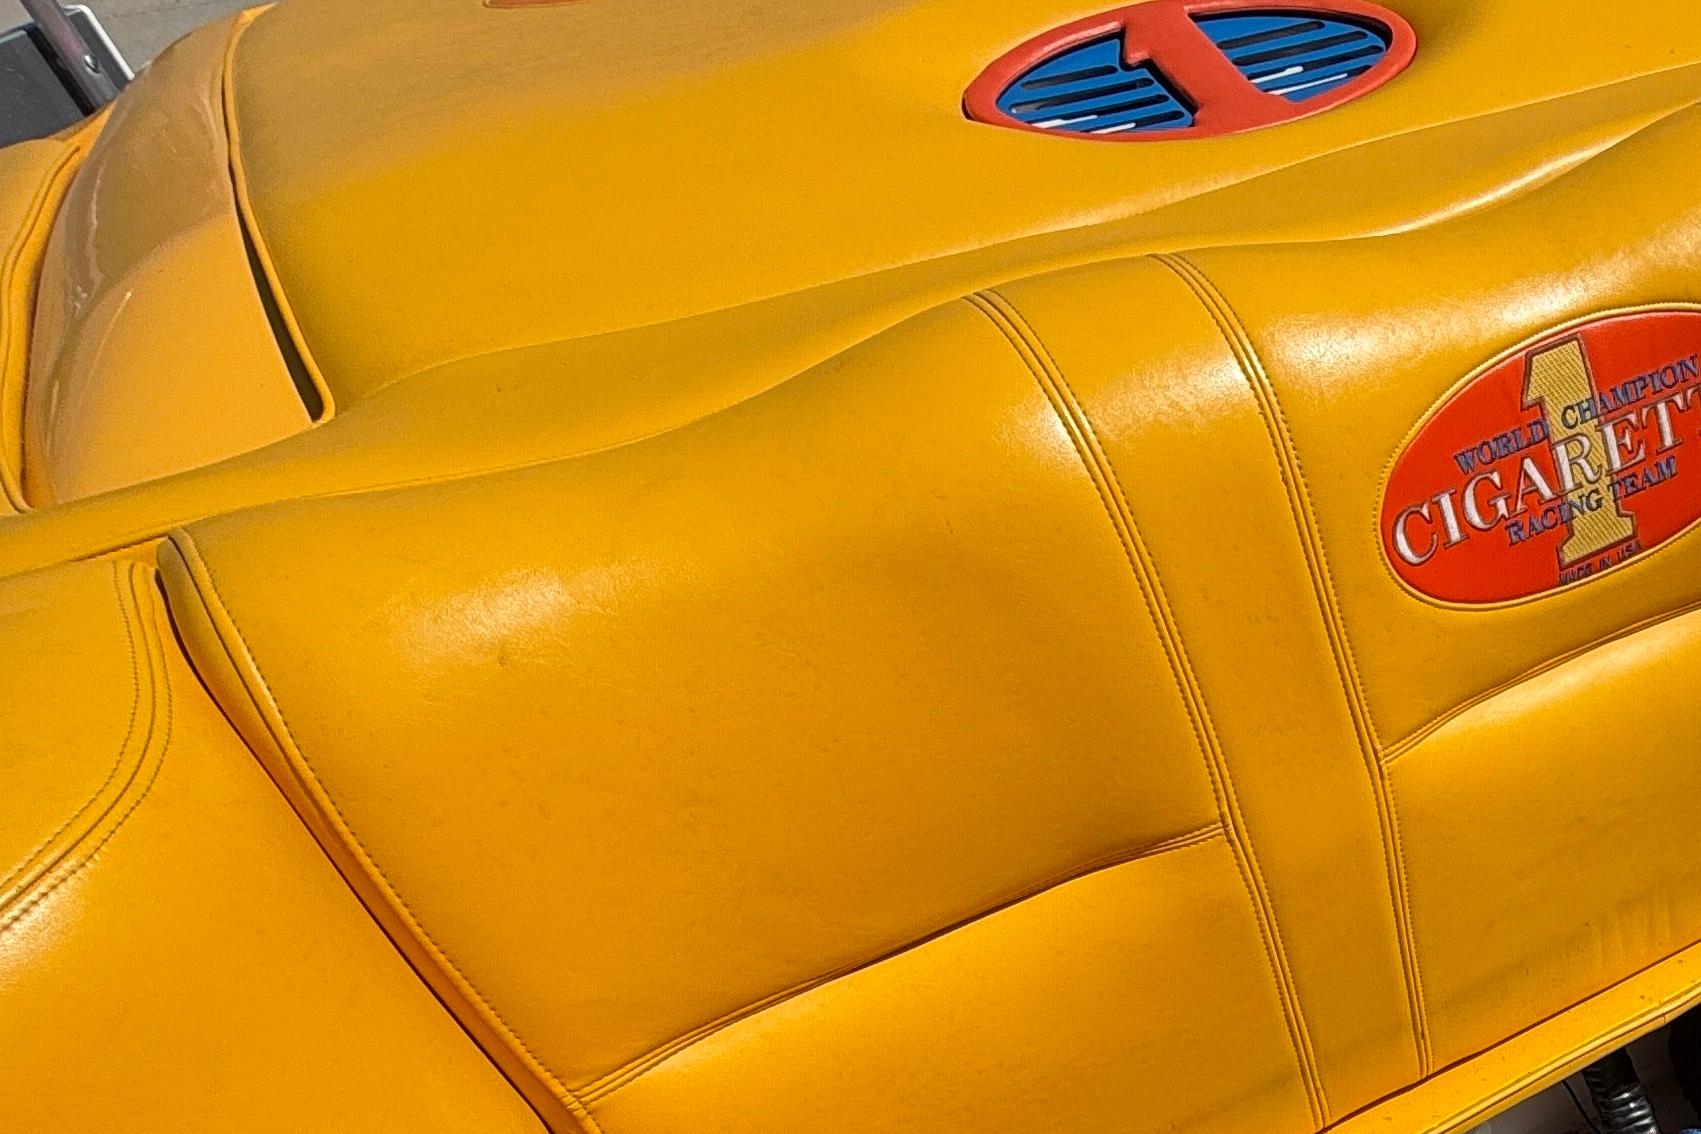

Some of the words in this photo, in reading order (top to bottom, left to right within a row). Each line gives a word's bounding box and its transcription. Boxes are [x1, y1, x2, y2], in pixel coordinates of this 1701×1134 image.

[1454, 420, 1550, 475] WORLD
[1561, 354, 1700, 430] CHAMPION
[1504, 487, 1603, 546] RACING
[1611, 455, 1678, 502] TEAM
